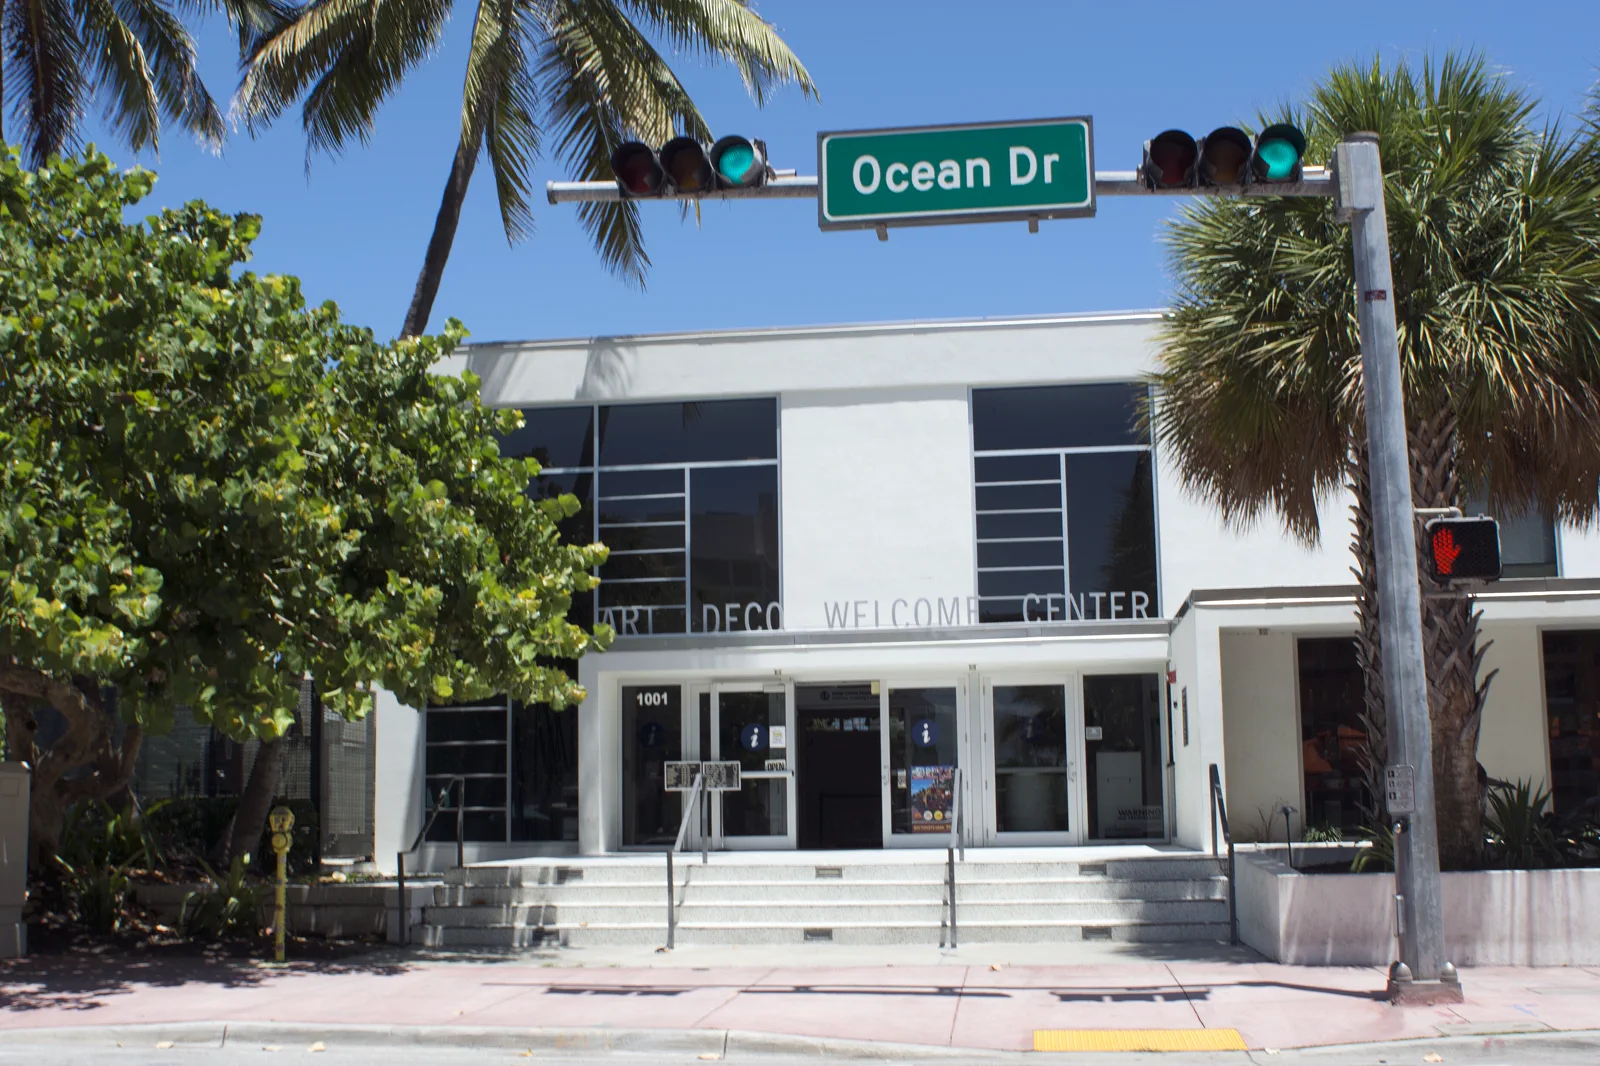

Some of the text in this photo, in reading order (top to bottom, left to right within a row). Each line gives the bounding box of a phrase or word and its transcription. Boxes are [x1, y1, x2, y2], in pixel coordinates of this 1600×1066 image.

[852, 145, 1060, 195] Ocean Dr
[601, 605, 656, 635] ART
[702, 600, 784, 633] DECO
[1022, 591, 1150, 623] CENTER
[636, 691, 669, 707] 1001
[767, 762, 785, 771] OPEN
